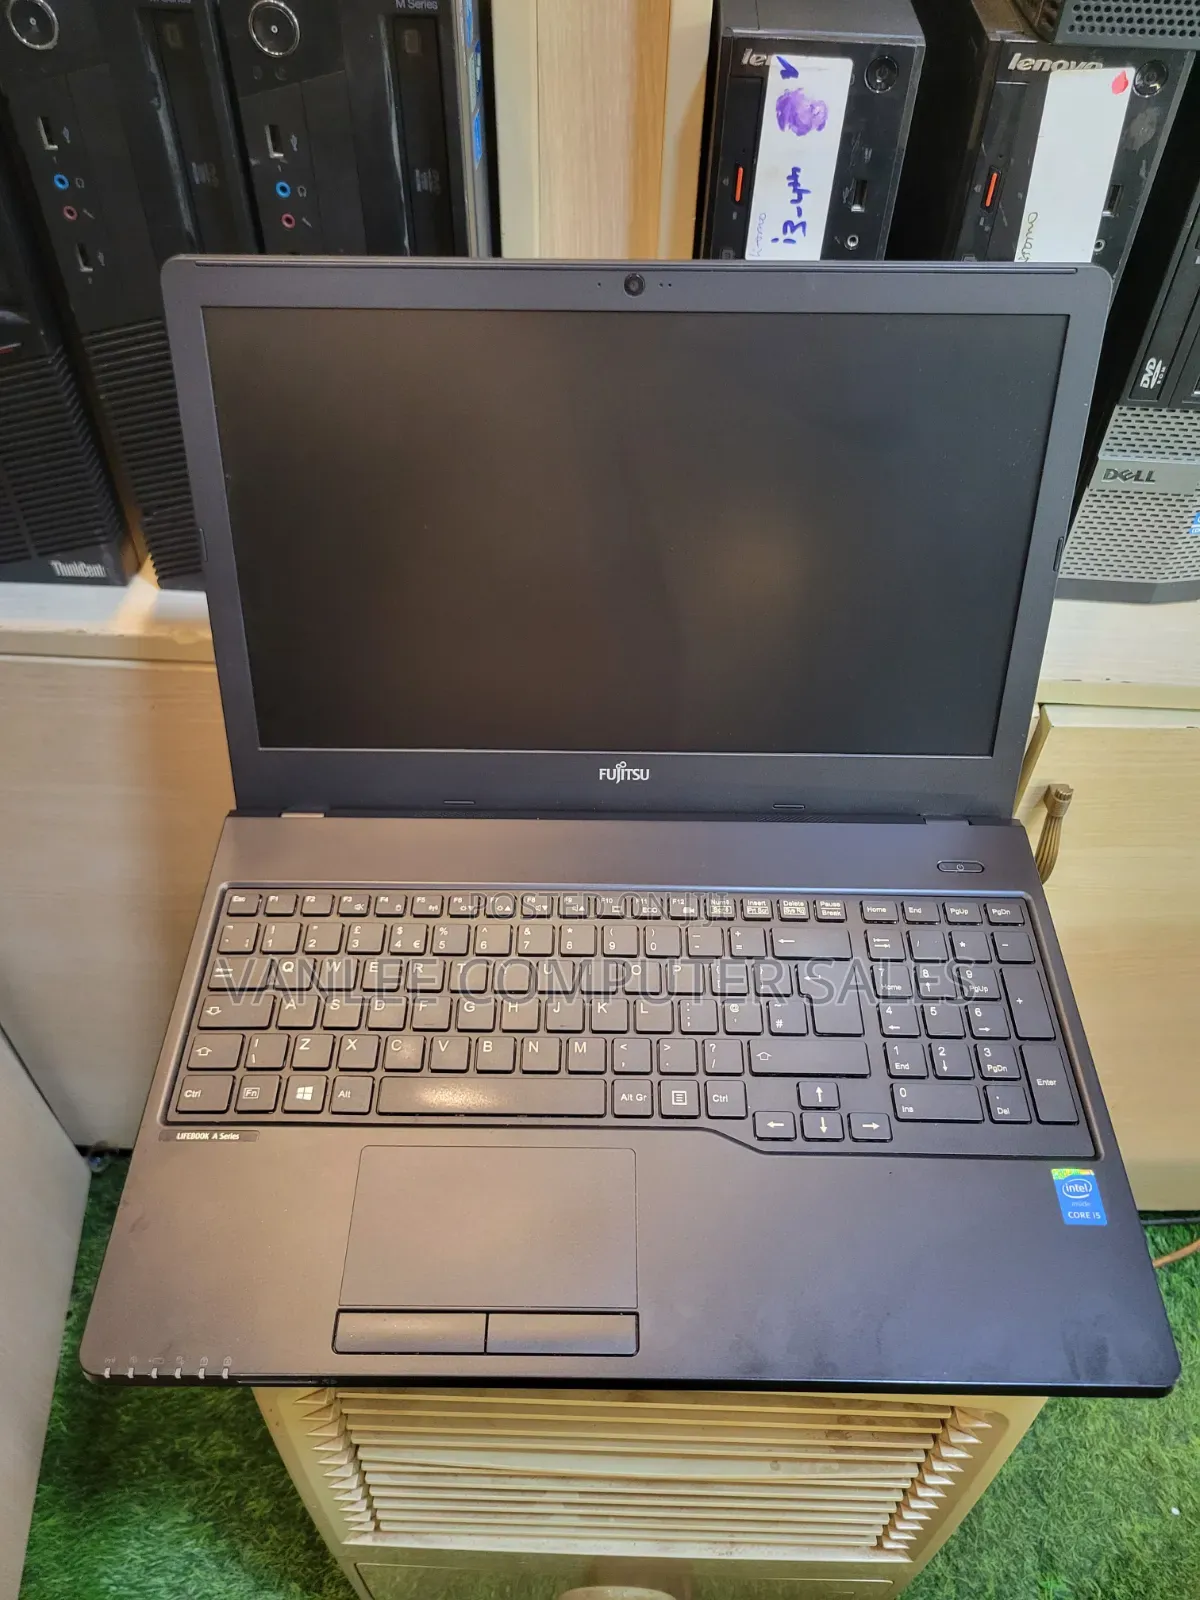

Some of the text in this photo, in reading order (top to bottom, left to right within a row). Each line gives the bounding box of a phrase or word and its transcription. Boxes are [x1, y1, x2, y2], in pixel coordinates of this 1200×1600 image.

[407, 0, 438, 10] Series
[1140, 357, 1157, 389] DVD
[1102, 468, 1156, 484] DELL
[599, 760, 650, 785] FUJITSU
[950, 907, 969, 916] PgUp
[991, 908, 1011, 917] PgDn
[353, 926, 362, 935] £
[439, 927, 448, 936] %
[523, 927, 531, 936] &
[268, 939, 273, 948] 1
[308, 940, 317, 948] 2
[351, 940, 359, 948] 3
[394, 940, 402, 948] 4
[413, 940, 421, 949] €
[439, 941, 446, 949] 5
[480, 941, 487, 949] 6
[523, 941, 530, 949] 7
[566, 941, 573, 950] 8
[608, 942, 616, 950] 9
[282, 962, 295, 973] Q
[326, 961, 342, 972] W
[369, 962, 379, 972] E
[413, 963, 424, 973] R
[631, 964, 642, 976] O
[922, 968, 930, 978] 8
[965, 970, 973, 979] 9
[969, 985, 989, 993] PgUp
[285, 1000, 297, 1010] A
[330, 1000, 341, 1011] S
[374, 1000, 386, 1011] D
[419, 1001, 429, 1012] F
[464, 1001, 476, 1013] G
[508, 1002, 518, 1013] H
[553, 1002, 561, 1013] J
[597, 1003, 608, 1014] K
[640, 1003, 649, 1014] L
[729, 1003, 740, 1013] @
[886, 1006, 893, 1015] 4
[930, 1007, 937, 1016] 5
[975, 1008, 982, 1017] 6
[776, 1019, 784, 1029] #
[299, 1038, 310, 1050] Z
[346, 1038, 358, 1050] X
[391, 1039, 402, 1051] C
[438, 1040, 450, 1051] V
[483, 1040, 493, 1052] B
[529, 1041, 539, 1053] N
[574, 1041, 587, 1053] M
[709, 1043, 716, 1053] ?
[894, 1046, 899, 1056] 1
[938, 1046, 946, 1057] 2
[984, 1047, 992, 1057] 3
[895, 1062, 910, 1070] End
[987, 1064, 1008, 1073] PgDn
[1036, 1078, 1057, 1086] Enter
[184, 1089, 202, 1099] Ctrl
[245, 1089, 258, 1097] Fn
[338, 1090, 351, 1099] Alt
[620, 1093, 647, 1101] Alt Gr
[900, 1087, 907, 1098] 0
[712, 1094, 729, 1103] Ctrl
[902, 1105, 914, 1113] Ins
[997, 1107, 1011, 1115] Del
[176, 1132, 240, 1140] LIFEBOOK A Series
[1065, 1182, 1089, 1193] intel
[1067, 1211, 1091, 1219] CORE
